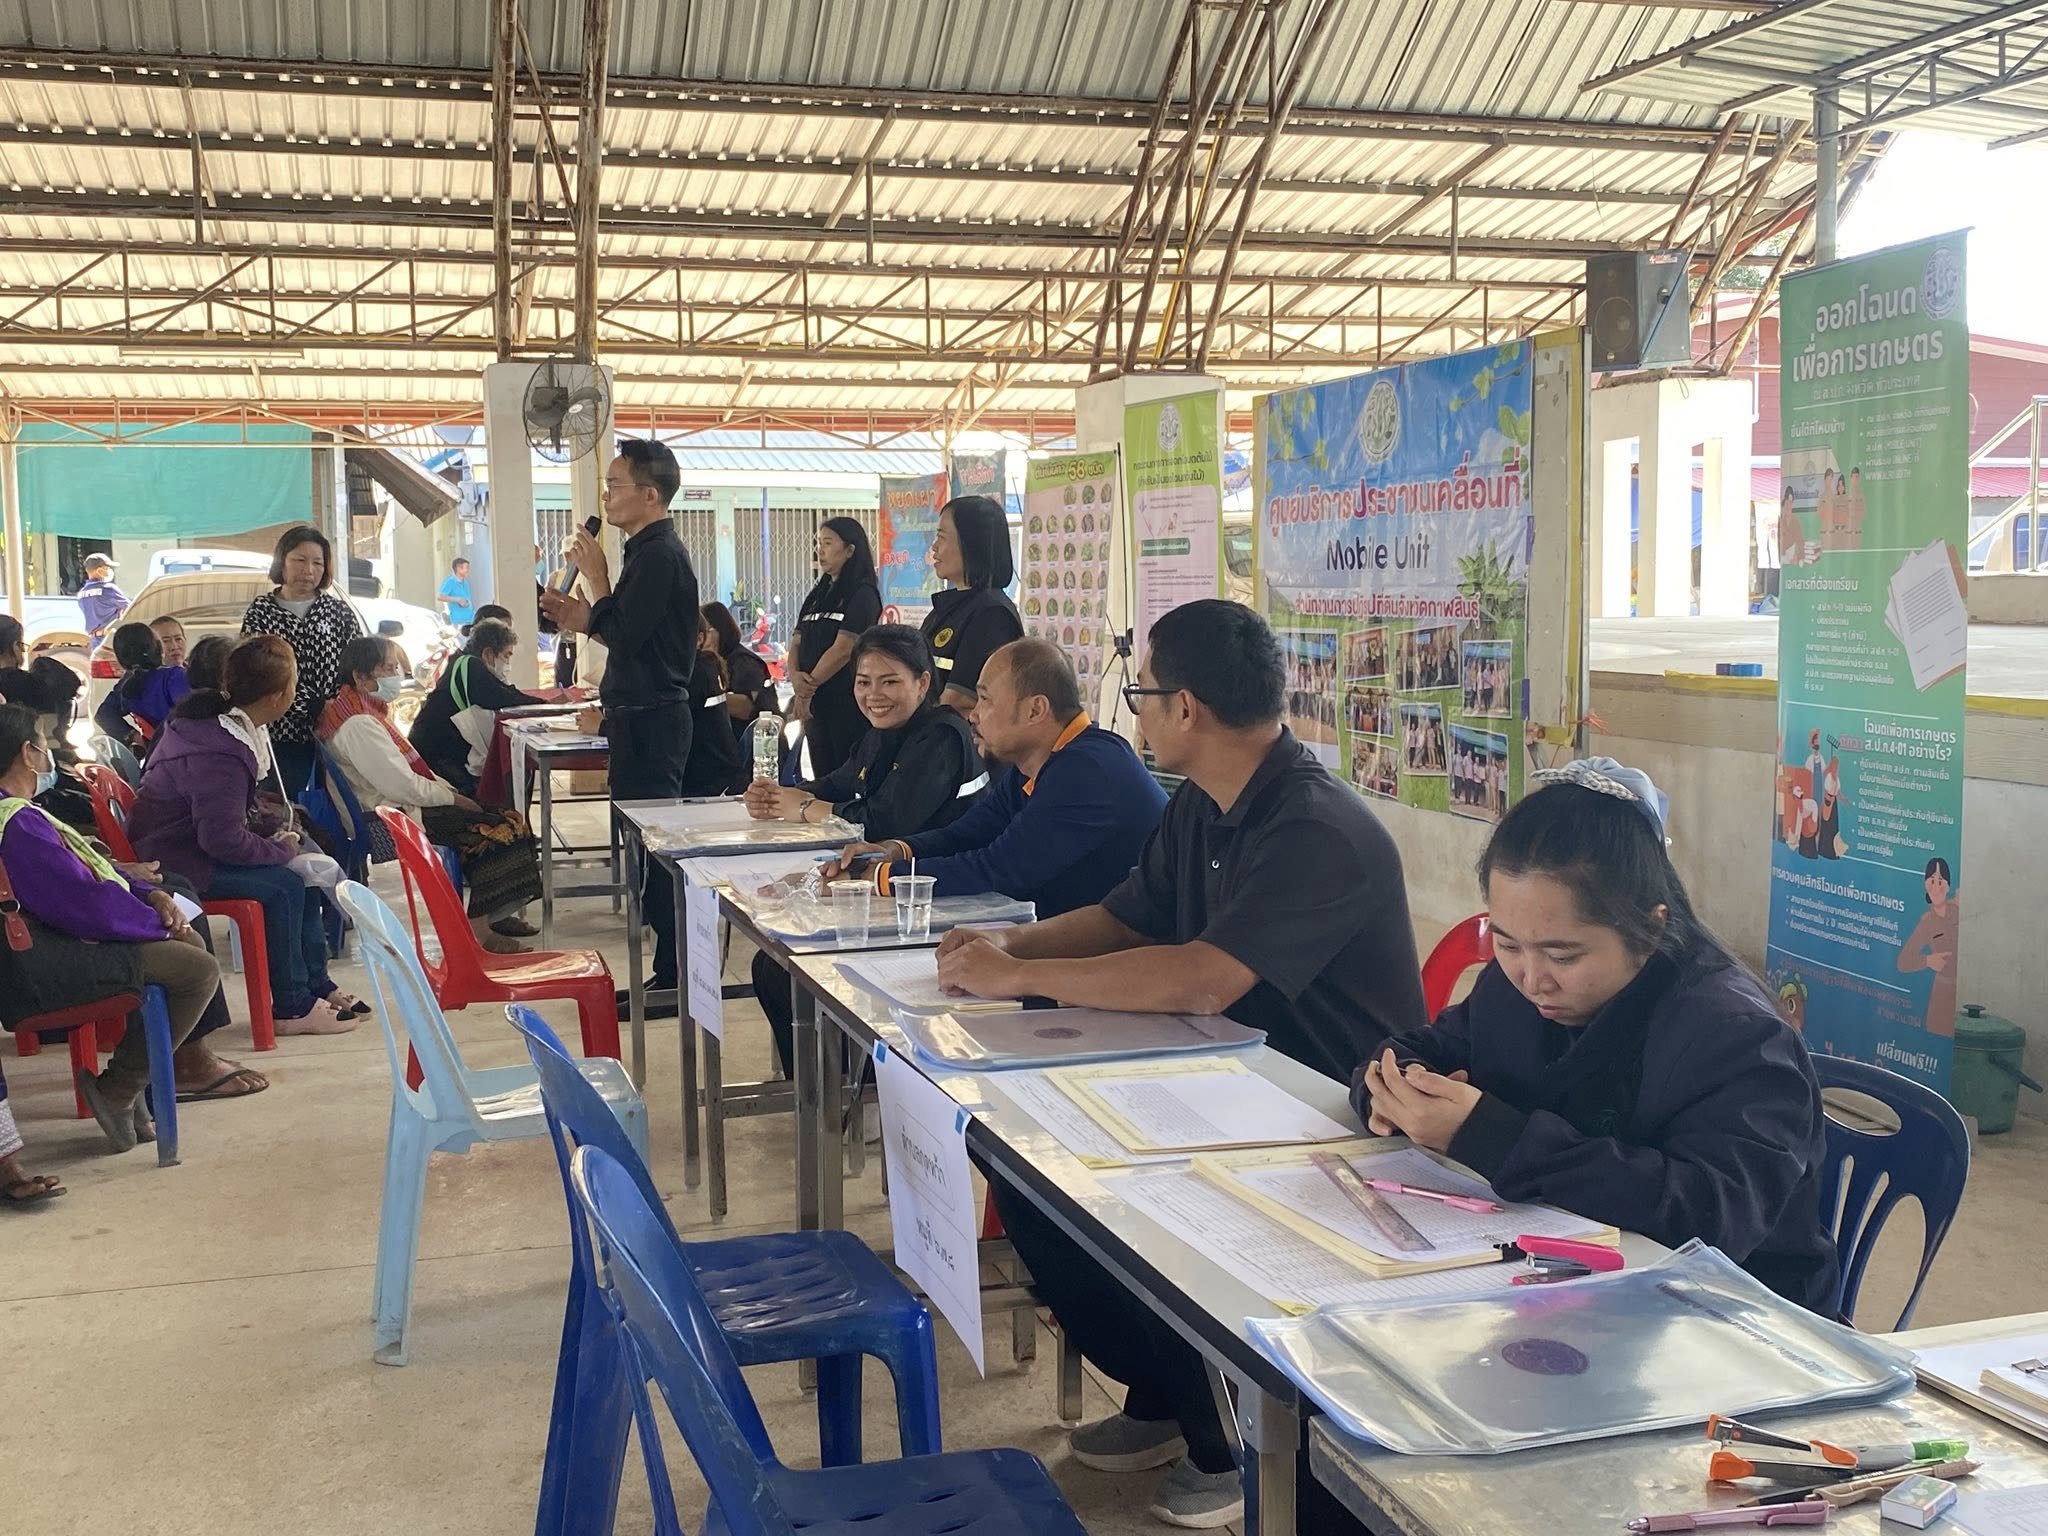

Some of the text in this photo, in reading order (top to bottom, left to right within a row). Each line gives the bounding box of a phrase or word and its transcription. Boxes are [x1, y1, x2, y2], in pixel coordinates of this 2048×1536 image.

[1816, 283, 1917, 333] ออกโฉนด
[1792, 332, 1944, 383] เพื่อการเกษตร
[1068, 459, 1086, 480] 58
[1269, 446, 1522, 538] ศูนย์บริการประชาชนเคลื่อนที่
[1326, 532, 1431, 572] Mobile Unit
[1863, 717, 1958, 745] โฉนดเพื่อการเกษตร
